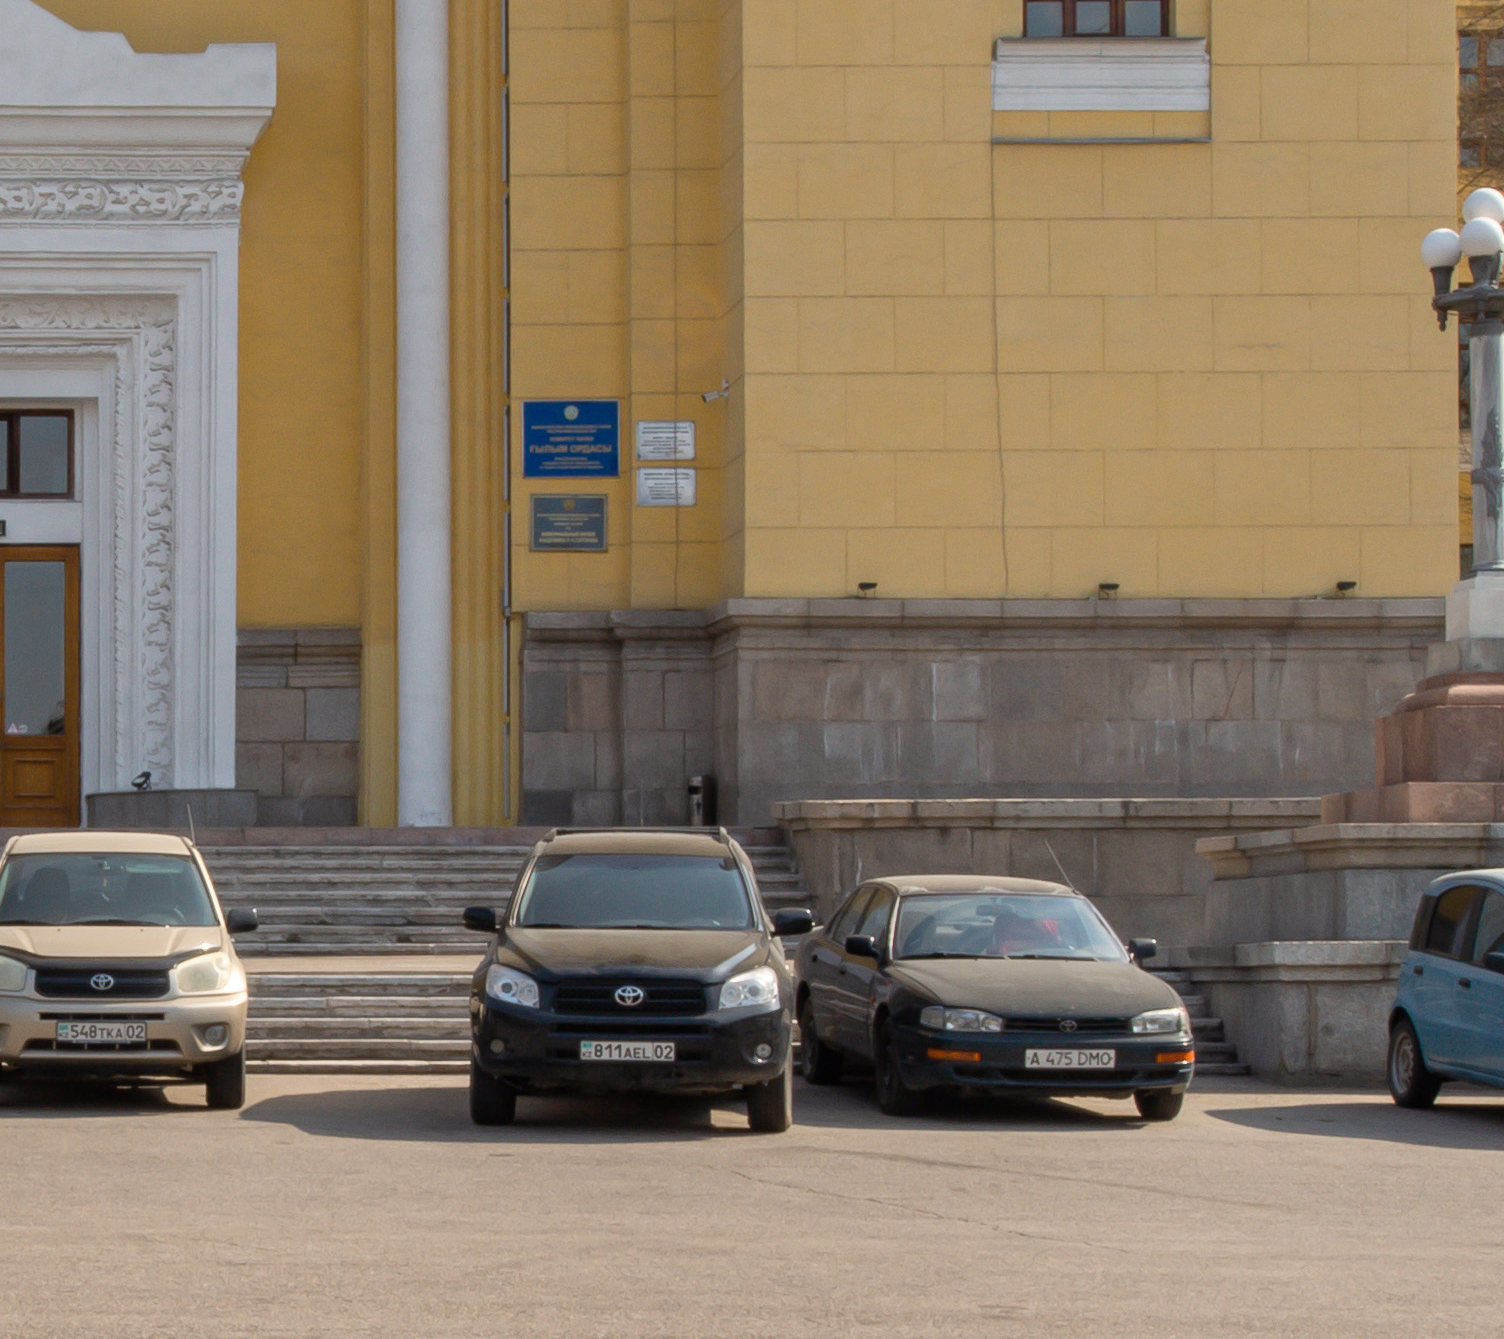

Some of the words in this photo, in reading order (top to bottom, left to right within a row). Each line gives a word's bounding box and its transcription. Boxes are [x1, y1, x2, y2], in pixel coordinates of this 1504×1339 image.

[126, 1025, 144, 1039] 02
[654, 1044, 673, 1059] 02
[1030, 1052, 1040, 1065] A
[1045, 1052, 1072, 1066] 475
